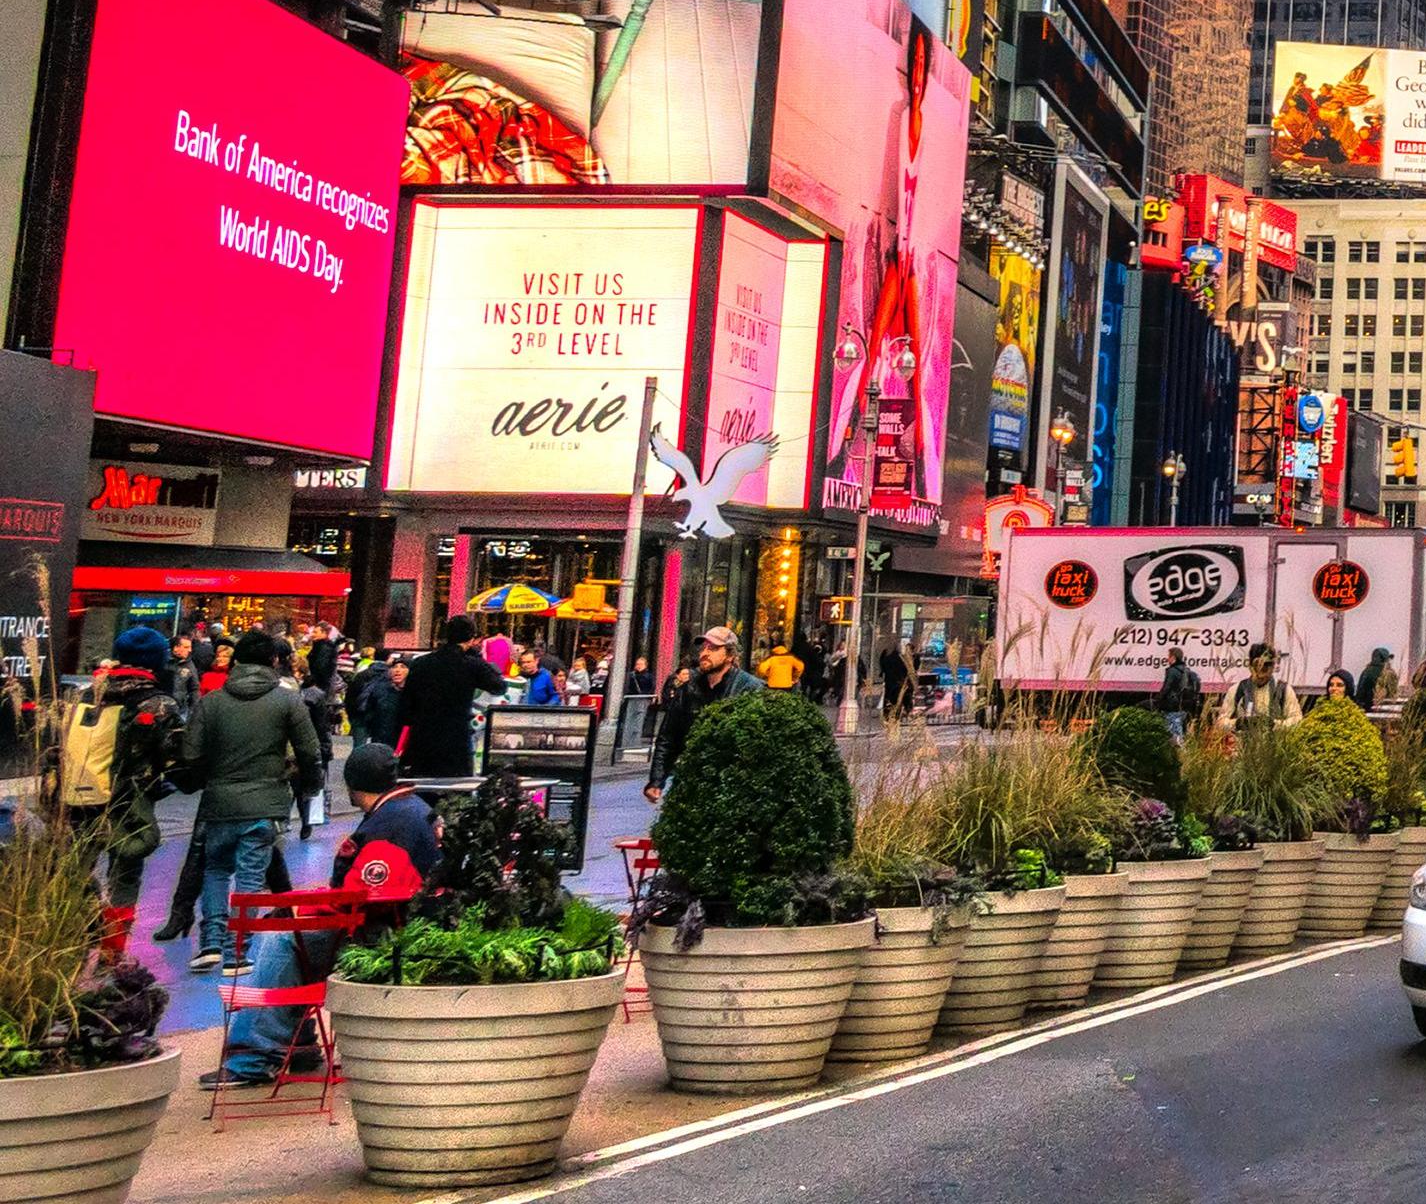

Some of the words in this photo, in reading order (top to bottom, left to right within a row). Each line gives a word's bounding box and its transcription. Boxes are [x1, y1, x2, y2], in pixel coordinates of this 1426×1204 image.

[174, 109, 222, 167] Bank
[224, 133, 248, 175] of
[246, 141, 313, 203] America
[315, 179, 390, 234] recognizes
[219, 204, 270, 259] World
[269, 225, 311, 273] AIDS
[313, 239, 344, 294] Day.
[522, 272, 584, 297] VISIT
[594, 272, 625, 296] US
[483, 302, 562, 326] INSIDE
[573, 303, 605, 326] ON
[617, 302, 658, 326] THE
[557, 332, 625, 356] LEVEL
[490, 380, 630, 438] aerie
[878, 412, 903, 424] SOME
[878, 423, 905, 435] WALLS
[1053, 570, 1090, 585] taxi
[1148, 563, 1222, 602] edge
[1322, 570, 1360, 587] taxi
[1051, 584, 1086, 597] truck
[1320, 586, 1358, 599] truck
[1113, 627, 1153, 646] (212)
[1156, 628, 1250, 647] 947-3343
